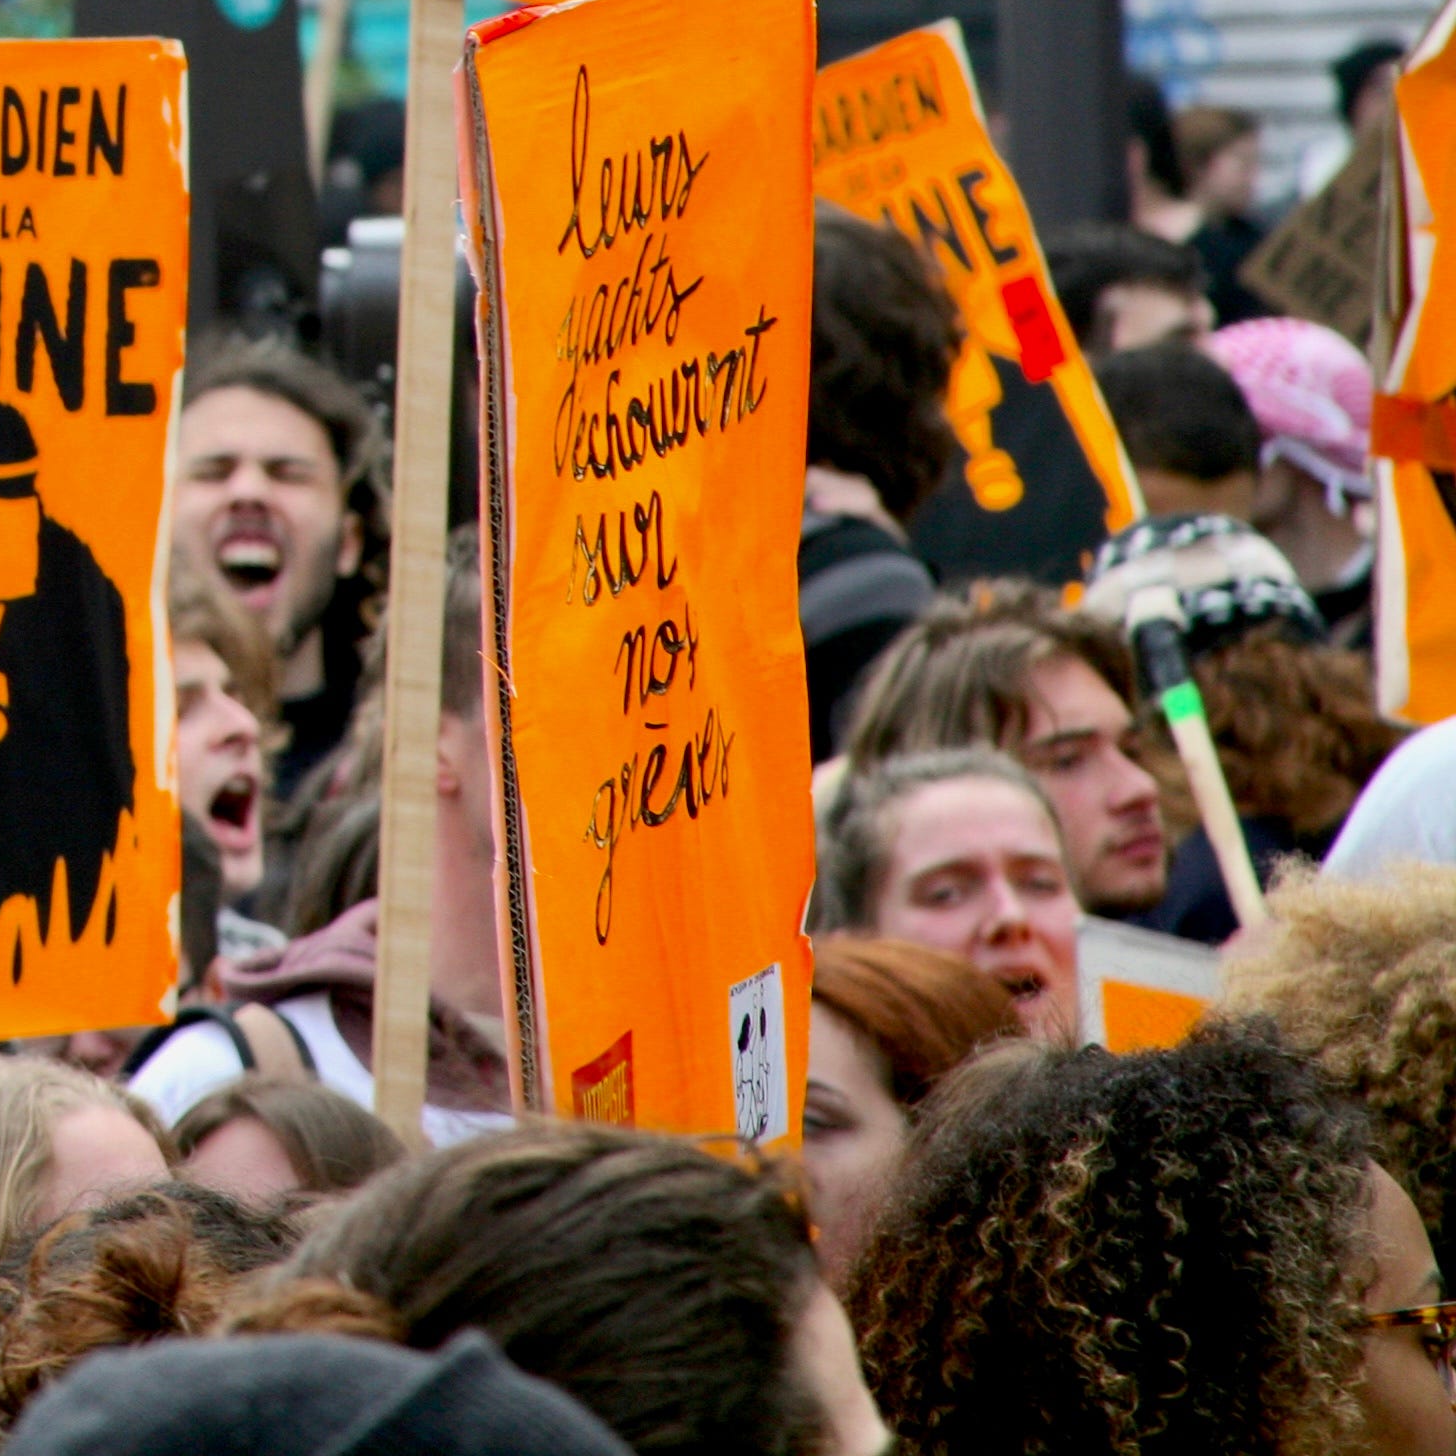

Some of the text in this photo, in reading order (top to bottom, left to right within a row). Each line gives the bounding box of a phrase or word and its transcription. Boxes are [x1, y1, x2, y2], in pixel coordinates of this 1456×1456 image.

[557, 63, 710, 260] leurs
[810, 57, 945, 166] ARDIEN
[0, 203, 39, 240] LA
[554, 233, 706, 478] yachts
[566, 490, 678, 608] sur
[614, 602, 699, 717] nos
